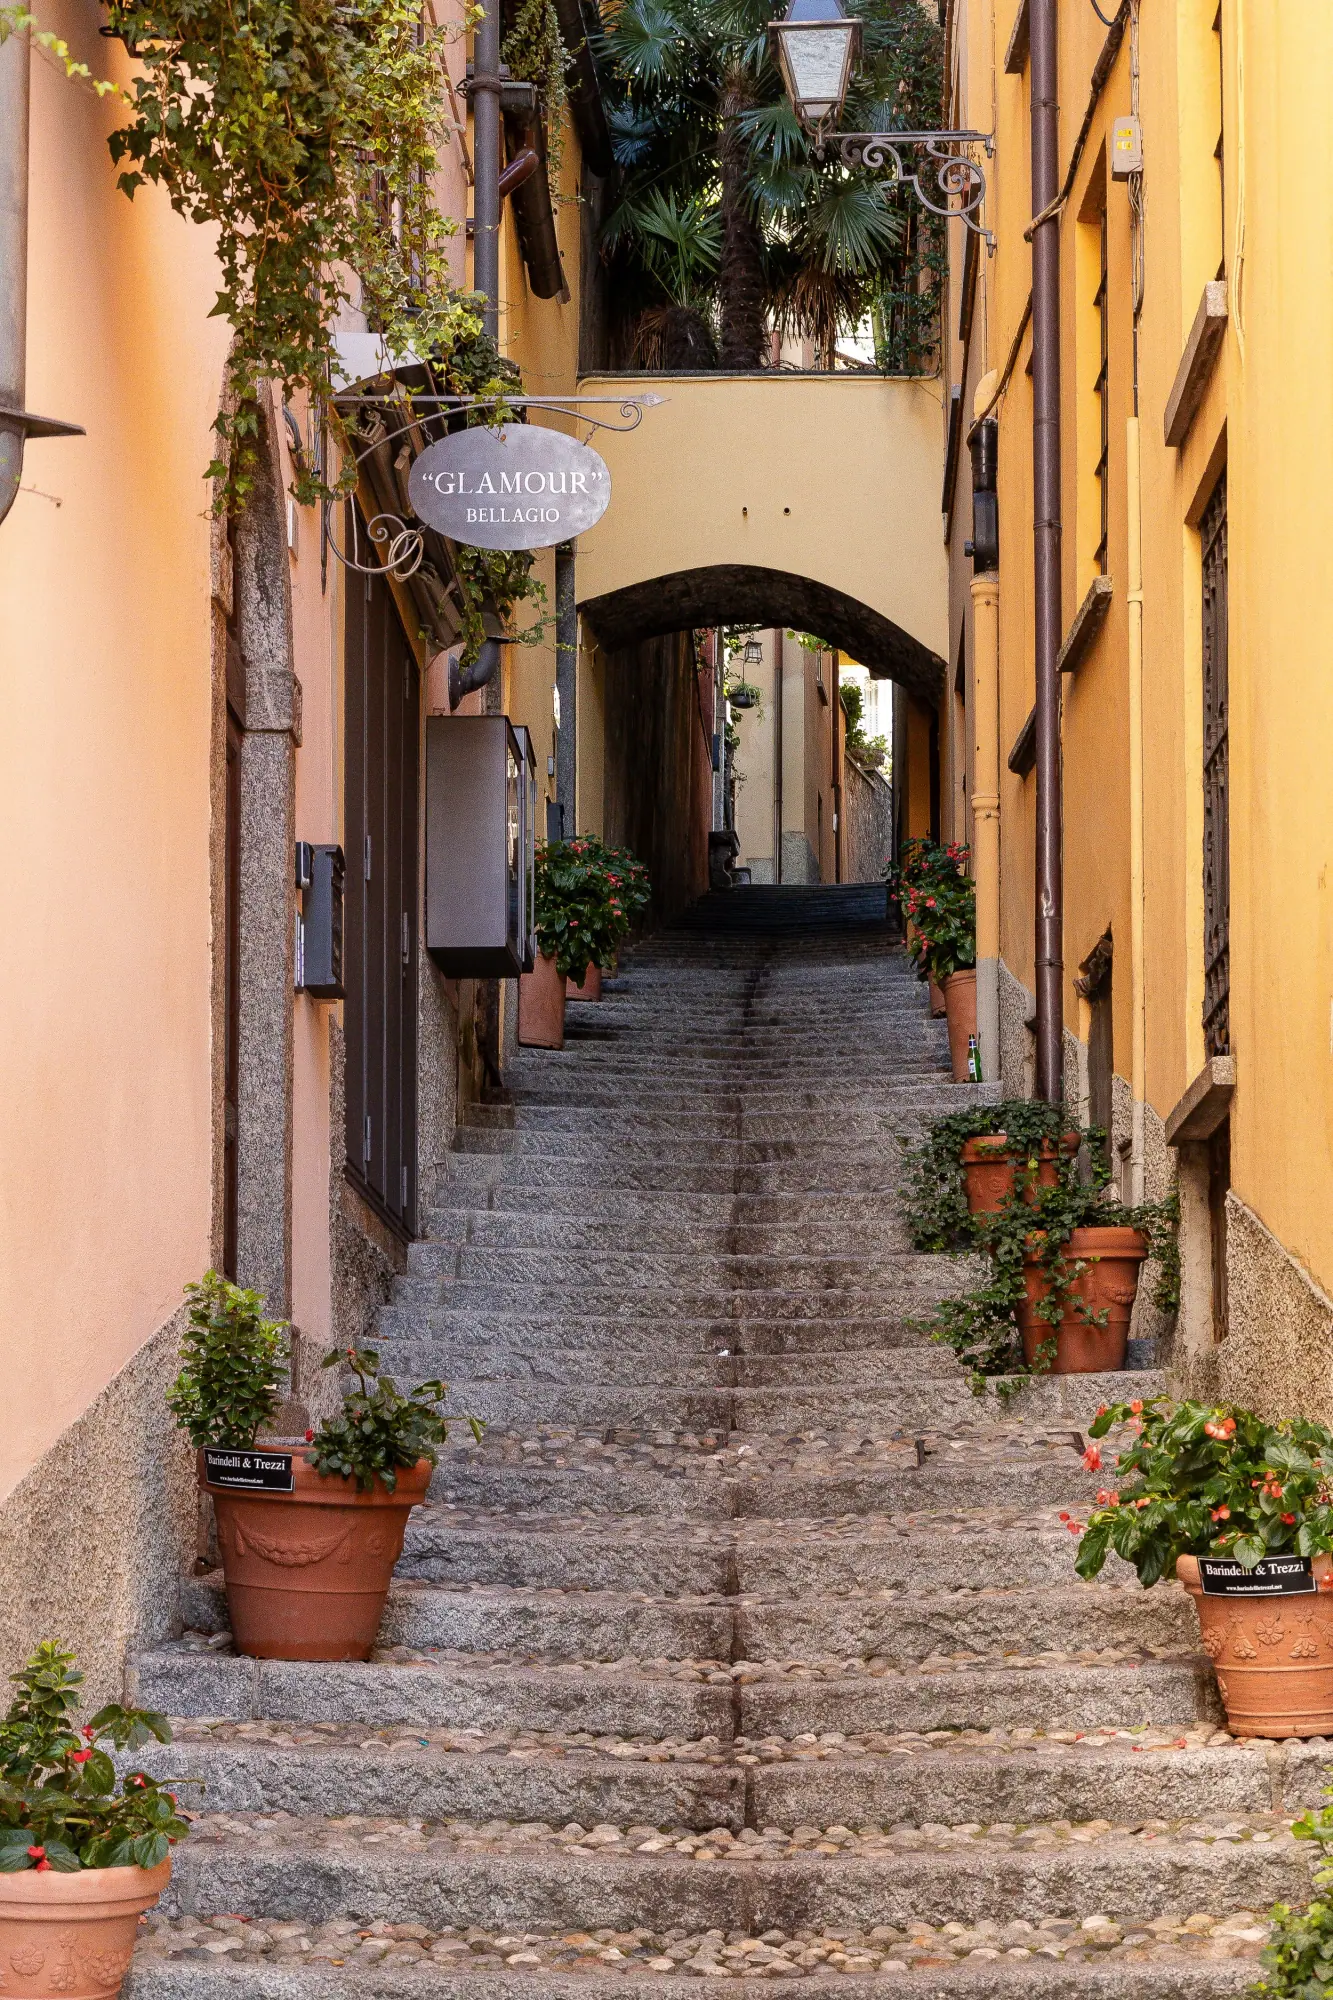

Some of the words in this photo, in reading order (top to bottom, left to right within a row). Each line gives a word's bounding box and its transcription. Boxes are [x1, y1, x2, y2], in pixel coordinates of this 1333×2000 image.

[422, 471, 603, 495] “GLAMOUR”
[466, 508, 560, 523] BELLAGIO
[208, 1454, 240, 1467] Barindelli
[242, 1458, 251, 1468] &
[254, 1458, 285, 1470] Trezzi
[1255, 1564, 1266, 1575] &
[1268, 1561, 1304, 1574] Trezzi
